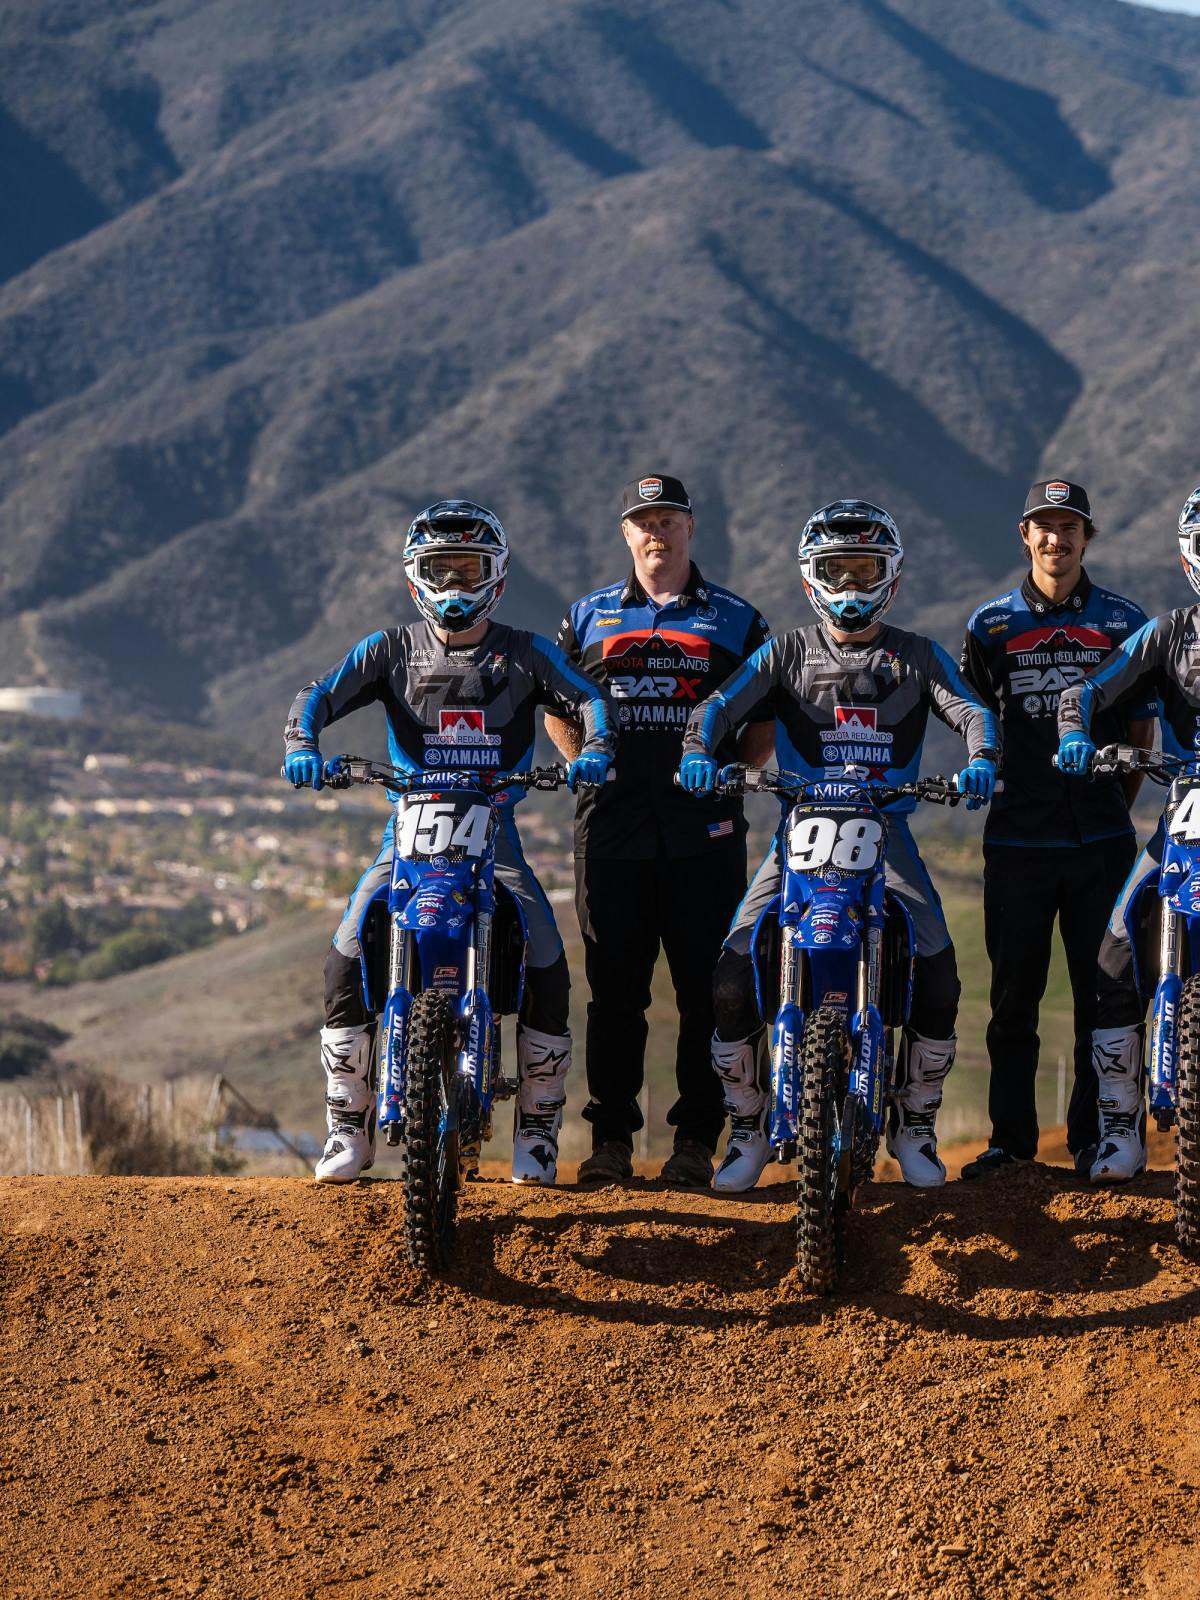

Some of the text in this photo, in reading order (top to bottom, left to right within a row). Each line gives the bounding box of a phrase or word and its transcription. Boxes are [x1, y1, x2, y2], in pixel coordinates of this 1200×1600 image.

[834, 534, 869, 544] BARX
[603, 657, 710, 673] TOYOTA REDLANDS
[1016, 653, 1051, 667] TOYOTA
[607, 675, 703, 699] BARX
[1009, 666, 1093, 695] BAR
[411, 674, 511, 706] FLY
[633, 705, 693, 723] YAMAH
[424, 735, 501, 744] TOYOTA REDLANDS
[820, 731, 892, 743] TOYOTA REDLANDS
[444, 750, 500, 765] YAMAHA
[839, 745, 891, 762] YAMAHA
[824, 765, 889, 782] BARX
[1093, 764, 1118, 772] ASV
[407, 793, 441, 802] BARX
[924, 791, 945, 800] ASV
[397, 803, 492, 859] 154
[787, 816, 882, 871] 98
